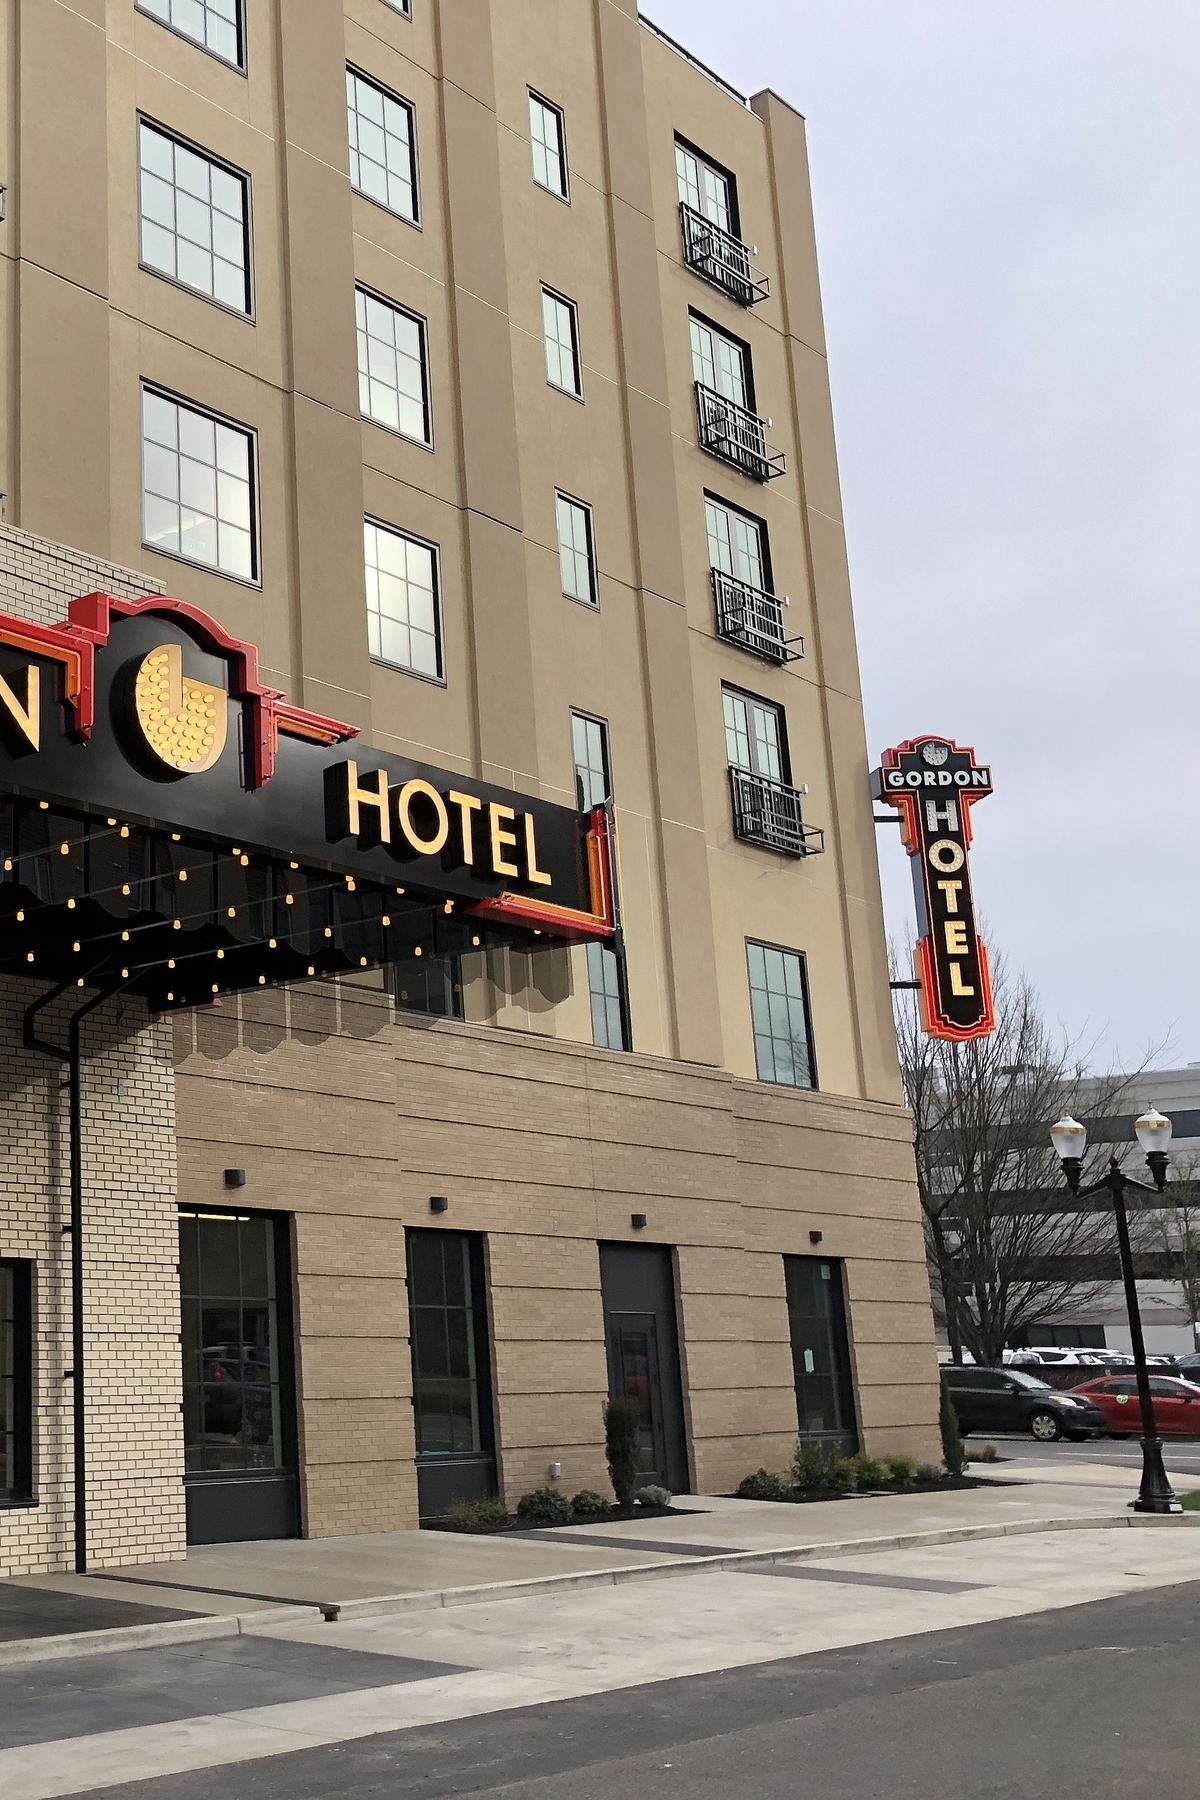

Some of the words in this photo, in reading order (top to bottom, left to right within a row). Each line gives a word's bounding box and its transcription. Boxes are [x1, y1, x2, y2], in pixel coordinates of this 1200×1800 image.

[347, 759, 552, 886] HOTEL
[888, 769, 989, 787] GORDON
[925, 799, 975, 996] HOTEL
